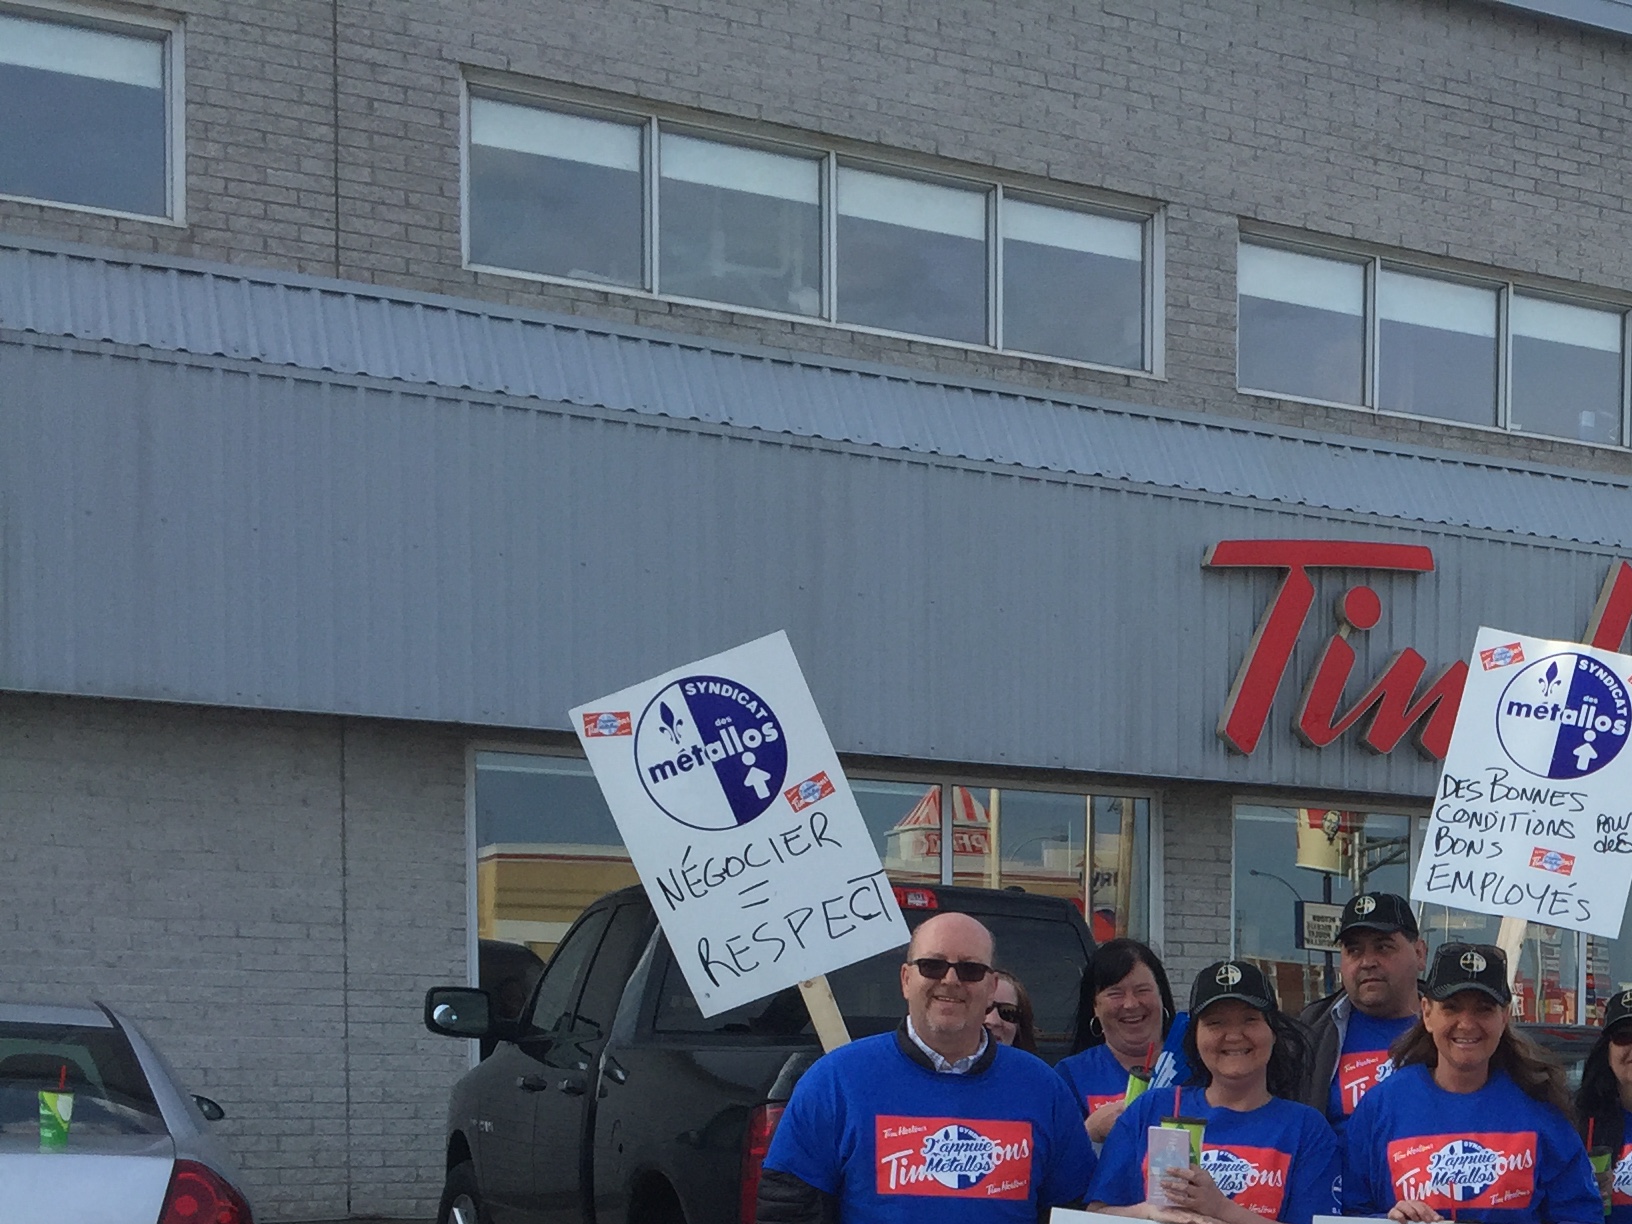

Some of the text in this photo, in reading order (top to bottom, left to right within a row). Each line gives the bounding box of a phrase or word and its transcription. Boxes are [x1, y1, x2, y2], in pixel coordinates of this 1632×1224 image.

[1205, 538, 1470, 763] Tim
[685, 682, 768, 720] SYNDICAT
[1578, 658, 1628, 718] SYNDICAT
[1583, 695, 1599, 705] des
[715, 716, 732, 728] des
[1506, 700, 1627, 737] métallos
[647, 721, 779, 785] métallos
[1440, 767, 1588, 812] DES BONNES
[656, 811, 842, 911] NÉGOCIER
[1434, 825, 1504, 859] BONS
[1426, 862, 1592, 922] EMPLOYÉS
[697, 869, 893, 988] RESPECT
[925, 1155, 993, 1173] Métallos
[1432, 1166, 1497, 1187] Métallos
